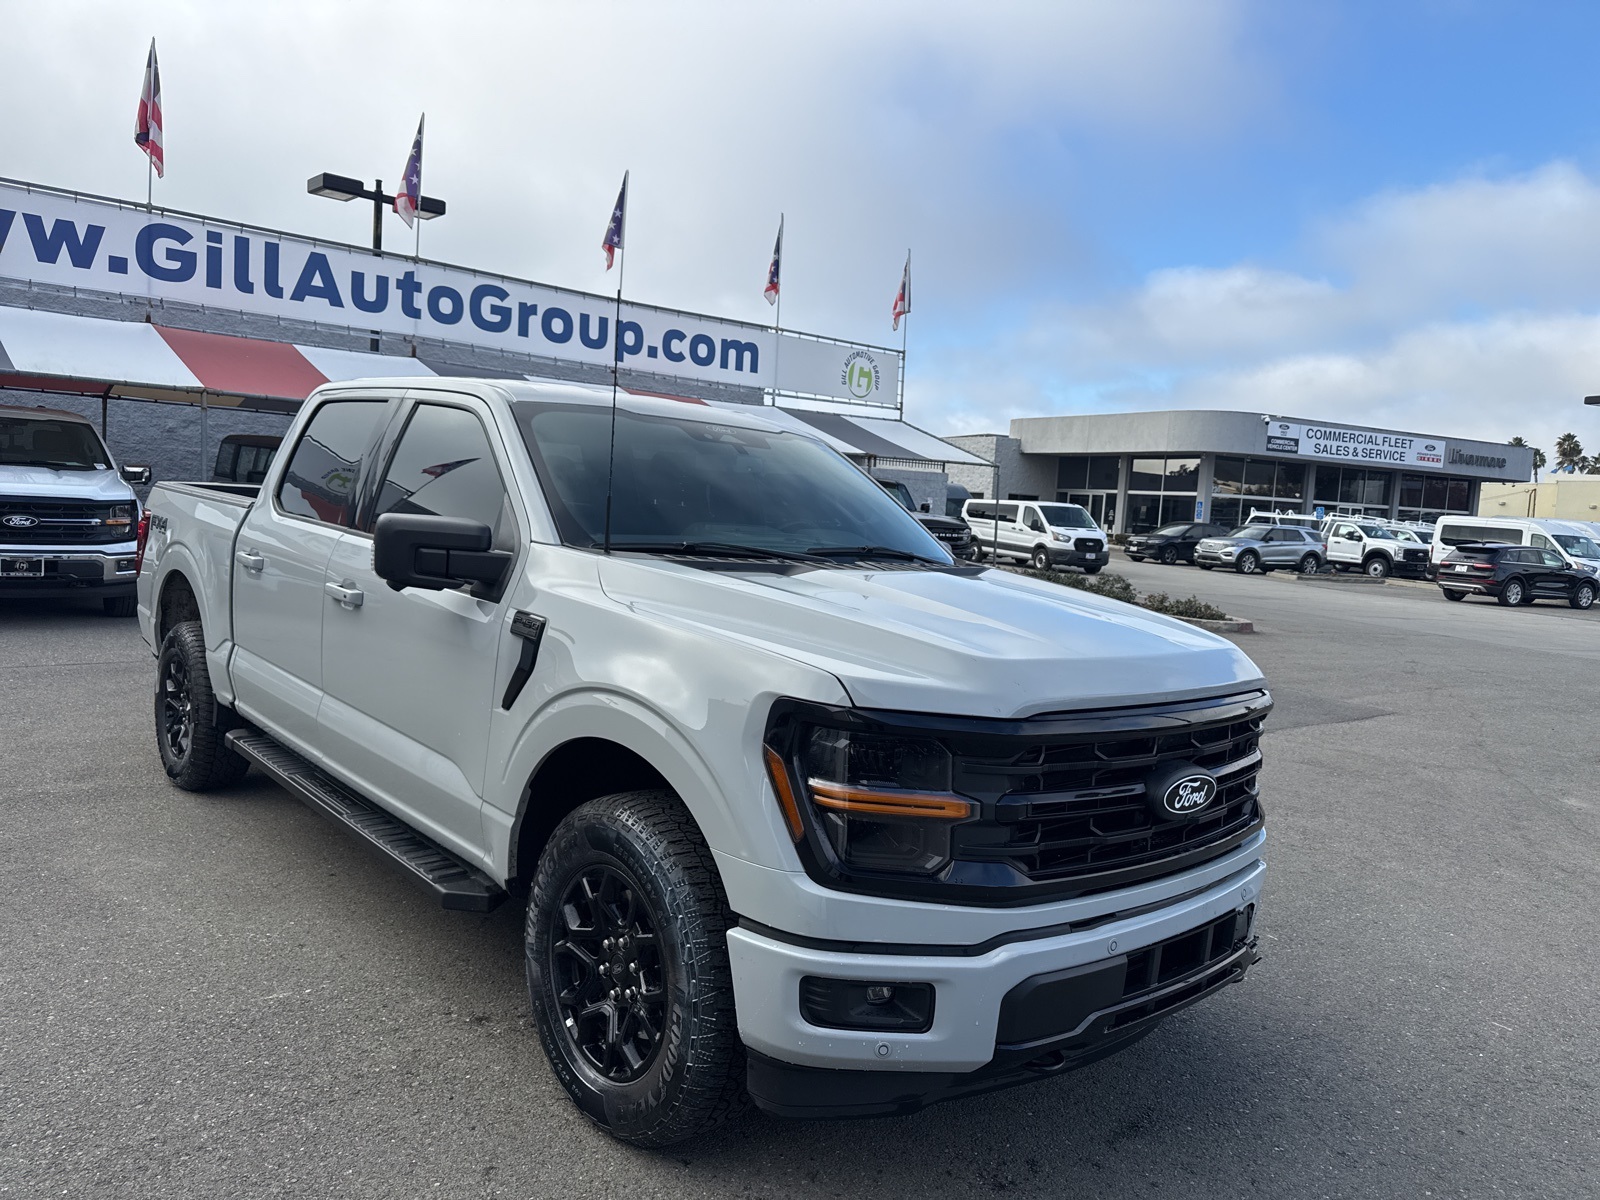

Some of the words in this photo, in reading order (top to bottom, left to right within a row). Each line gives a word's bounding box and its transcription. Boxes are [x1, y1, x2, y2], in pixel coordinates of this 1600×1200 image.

[0, 209, 759, 374] w.GillAutoGroup.com
[844, 351, 875, 369] AUTOMOTIVE
[1271, 438, 1295, 446] COMMERCIAL
[1306, 428, 1380, 446] COMMERCIAL
[1382, 436, 1414, 450] FLEET
[1313, 443, 1350, 457] SALES
[1352, 447, 1359, 458] &
[1361, 448, 1406, 462] SERVICE
[150, 514, 168, 531] FX4
[1174, 780, 1208, 809] Ford
